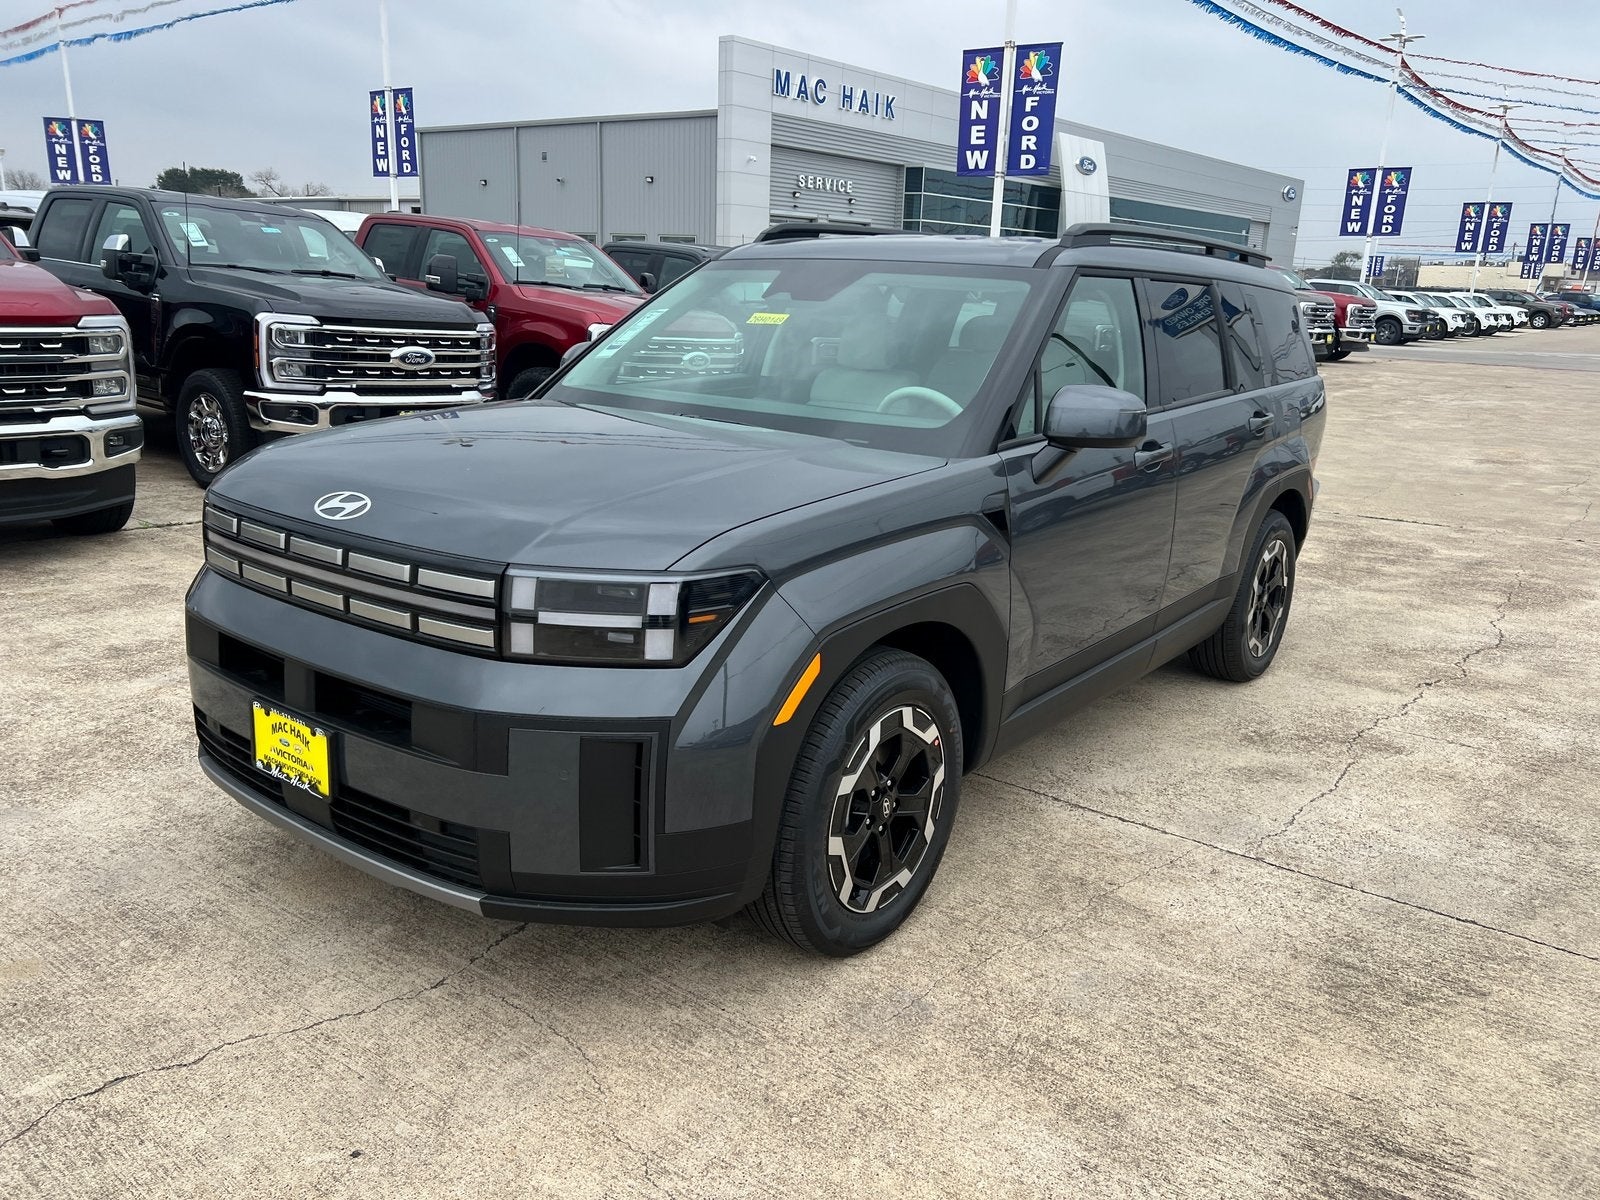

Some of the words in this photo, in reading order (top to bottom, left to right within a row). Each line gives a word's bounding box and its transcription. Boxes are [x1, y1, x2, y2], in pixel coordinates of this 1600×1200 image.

[774, 69, 827, 105] MAC
[841, 84, 896, 119] HAIK
[376, 124, 388, 172] NEW
[400, 124, 412, 172] FORD
[966, 100, 988, 170] NEW
[1020, 96, 1040, 170] FORD
[54, 144, 72, 180] NEW
[88, 146, 102, 182] FORD
[799, 174, 852, 192] SERVICE
[1346, 196, 1364, 232] NEW
[1381, 195, 1397, 234] FORD
[1461, 222, 1475, 250] NEW
[1488, 222, 1500, 250] FORD
[1529, 239, 1540, 262] NEW
[1550, 239, 1562, 262] FORD
[1576, 250, 1585, 270] NEW
[405, 352, 426, 364] Ford
[272, 722, 288, 735] MAC
[290, 724, 310, 752] HAIK
[267, 766, 288, 779] Mac
[276, 747, 309, 770] VICTORIA
